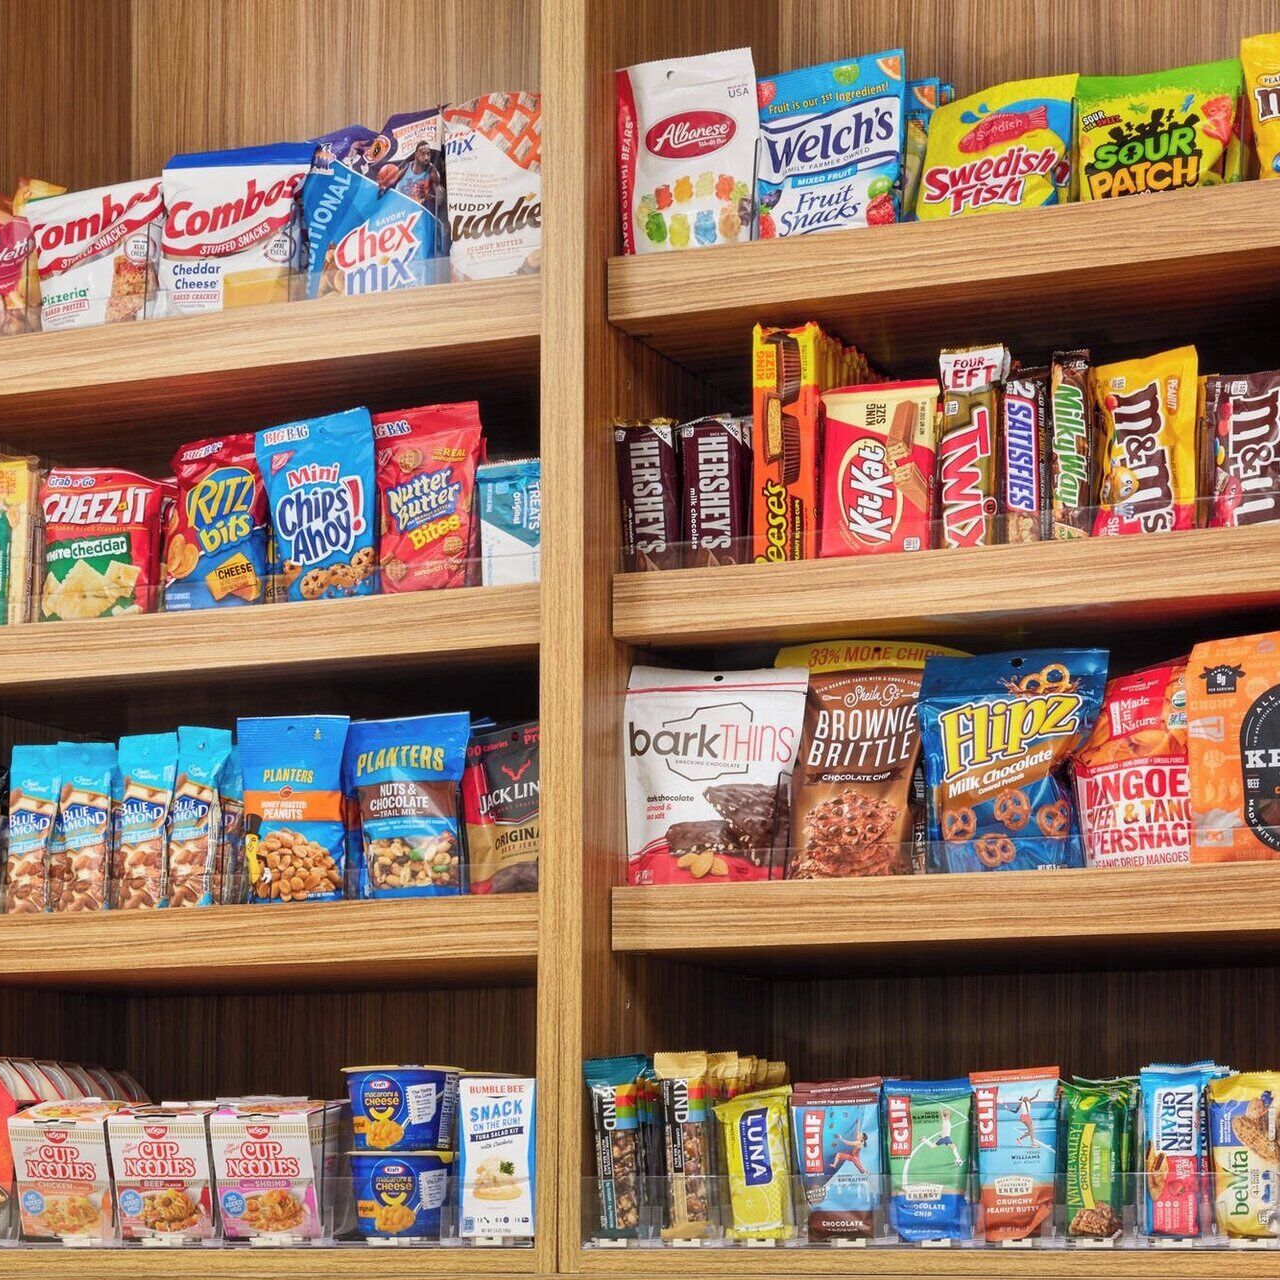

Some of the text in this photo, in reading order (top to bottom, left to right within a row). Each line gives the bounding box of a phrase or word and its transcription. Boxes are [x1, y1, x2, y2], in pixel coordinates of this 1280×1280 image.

[728, 87, 749, 98] USA
[656, 122, 731, 151] Albanese
[763, 107, 894, 174] Welch's
[1095, 127, 1194, 170] SOUR
[798, 168, 853, 186] MIXED FRUIT
[924, 147, 1056, 199] Swedish
[1089, 158, 1201, 199] PATCH
[164, 170, 305, 239] Combos
[449, 203, 493, 212] MUDDY
[797, 186, 853, 213] Fruit
[948, 178, 1022, 213] Fish
[375, 210, 406, 226] SAVORY
[780, 201, 861, 238] Snacks
[336, 214, 421, 267] Chex
[173, 263, 221, 277] Cheddar
[176, 278, 216, 290] Cheese
[953, 358, 985, 367] FOUR
[866, 402, 876, 426] KING
[876, 402, 886, 425] SIZE
[1007, 403, 1035, 511] SATISFIES
[288, 463, 339, 488] Mini
[389, 468, 451, 512] Nutter
[397, 484, 459, 525] Butter
[630, 440, 667, 553] HERSHEY'S
[698, 436, 730, 549] HERSHEY'S
[278, 484, 348, 535] Chips
[511, 492, 521, 525] Original
[408, 515, 460, 549] Bites
[72, 538, 126, 556] cheddar
[816, 705, 918, 741] BROWNIE
[357, 745, 445, 776] PLANTERS
[807, 738, 911, 768] BRITTLE
[263, 769, 314, 783] PLANTERS
[1247, 779, 1260, 788] BEEF
[264, 808, 302, 820] PEANUTS
[371, 796, 428, 809] CHOCOLATE
[380, 808, 417, 817] TRAIL MIX
[1121, 852, 1189, 867] DRIED MANGOES
[470, 1085, 502, 1093] BUMBLE
[674, 1078, 689, 1123] KIND
[470, 1100, 523, 1117] SNACK
[890, 1099, 909, 1140] CLIF
[978, 1088, 997, 1133] CLIF
[1161, 1091, 1177, 1154] GRAIN
[473, 1118, 521, 1130] ON THE RUN!
[806, 1112, 822, 1157] CLIF
[40, 1145, 79, 1162] CUP
[139, 1141, 179, 1159] CUP
[241, 1141, 282, 1159] CUP
[748, 1115, 768, 1178] LUNA
[26, 1162, 96, 1180] NOODLES
[124, 1158, 196, 1177] NOODLES
[227, 1158, 299, 1178] NOODLES
[1081, 1141, 1091, 1191] CRUNCHY
[1230, 1150, 1249, 1217] belVita
